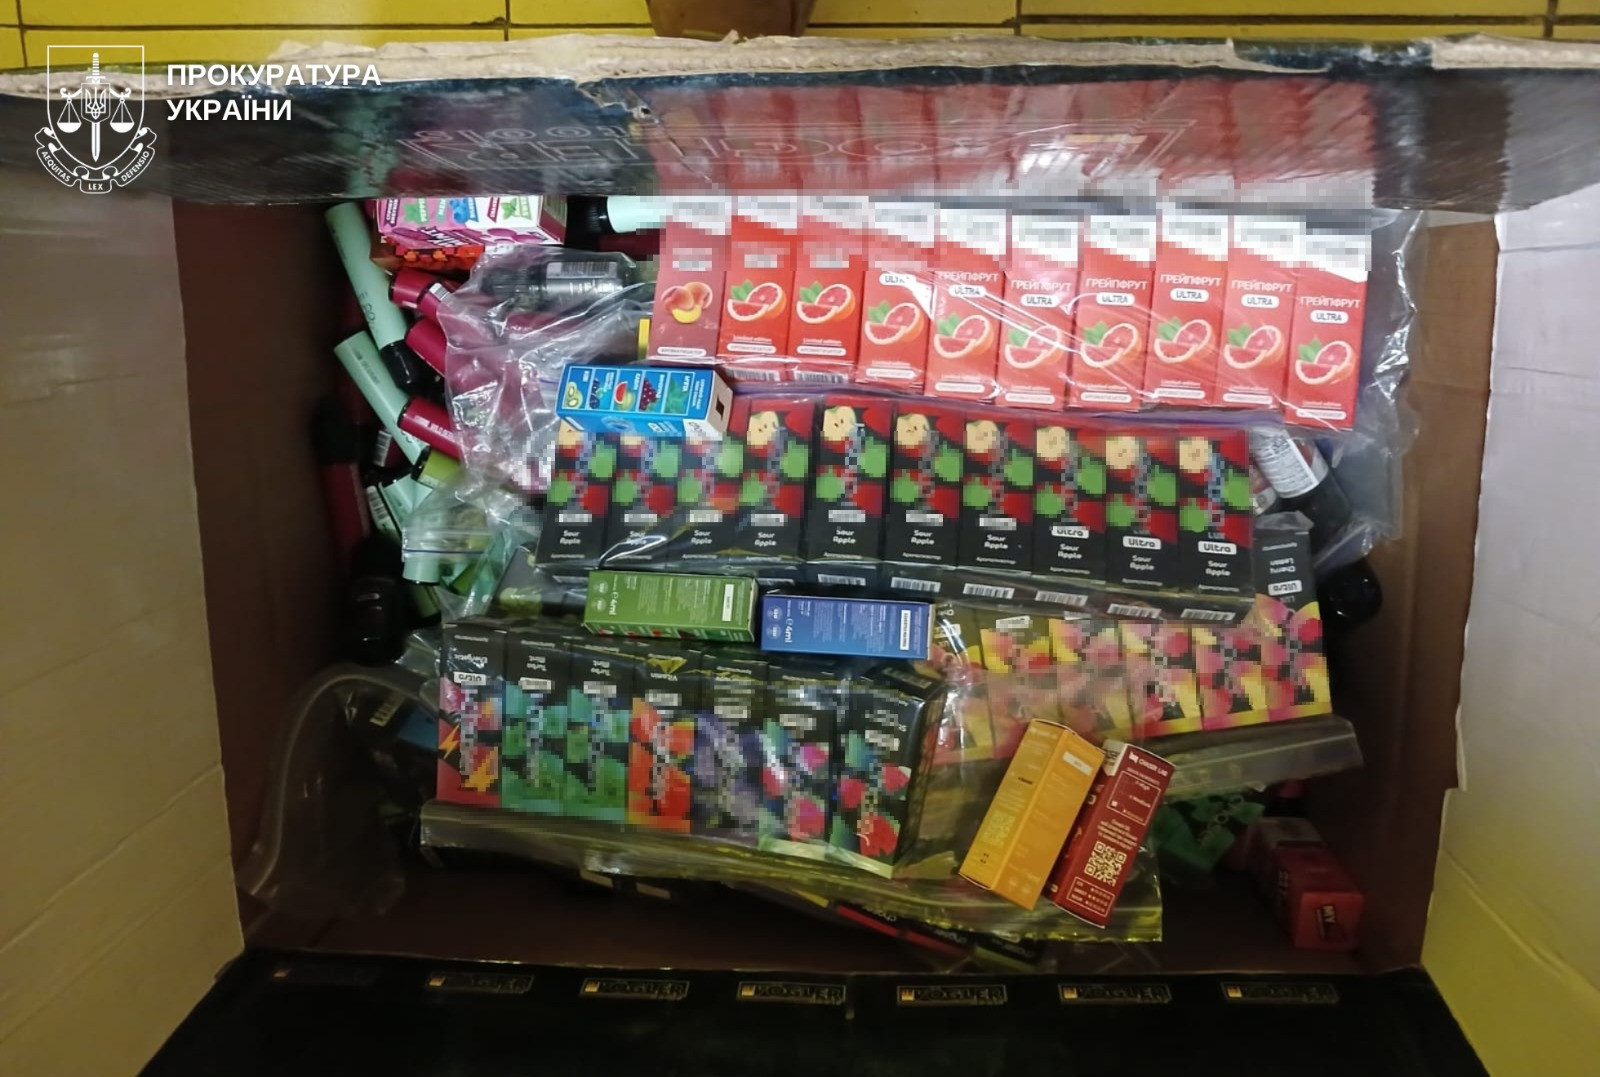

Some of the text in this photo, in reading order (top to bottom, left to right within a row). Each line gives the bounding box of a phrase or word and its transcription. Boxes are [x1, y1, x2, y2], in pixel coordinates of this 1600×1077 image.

[1085, 278, 1147, 290] ГРЕЙПФРУТ
[1160, 274, 1222, 286] ГРЕЙПФРУТ
[1010, 279, 1072, 291] ГРЕЙПФРУТ
[1230, 279, 1293, 292] ГРЕЙПФРУТ
[954, 287, 981, 296] ULTRA
[1176, 290, 1202, 300] ULTRA
[1026, 296, 1053, 306] ULTRA
[1101, 294, 1129, 303] ULTRA
[1246, 296, 1273, 306] ULTRA
[1300, 295, 1361, 308] ГРЕЙПФРУТ
[1316, 313, 1342, 322] ULTRA
[694, 529, 711, 537] Sour
[835, 528, 855, 536] Sour
[913, 529, 933, 537] Sour
[1056, 528, 1084, 537] Ultra
[560, 537, 582, 545] Apple
[691, 537, 713, 545] Apple
[754, 539, 777, 547] Apple
[832, 536, 857, 544] Apple
[910, 536, 935, 545] Apple
[1128, 539, 1156, 548] Ultra
[984, 541, 1009, 549] Apple
[1059, 543, 1080, 551] Sour
[1203, 544, 1232, 553] Ultra
[1057, 550, 1083, 559] Apple
[1132, 554, 1152, 563] Sour
[1129, 561, 1155, 571] Apple
[1207, 560, 1228, 568] Sour
[1269, 557, 1294, 566] Lemon
[1205, 567, 1231, 577] Apple
[1269, 565, 1296, 574] Cherry
[1272, 582, 1297, 592] Ultra
[608, 599, 618, 616] 4ml
[784, 626, 793, 643] 4ml
[526, 662, 547, 671] Turbo
[590, 667, 611, 676] Turbo
[1138, 757, 1158, 772] CHASER
[1157, 765, 1169, 777] LAB
